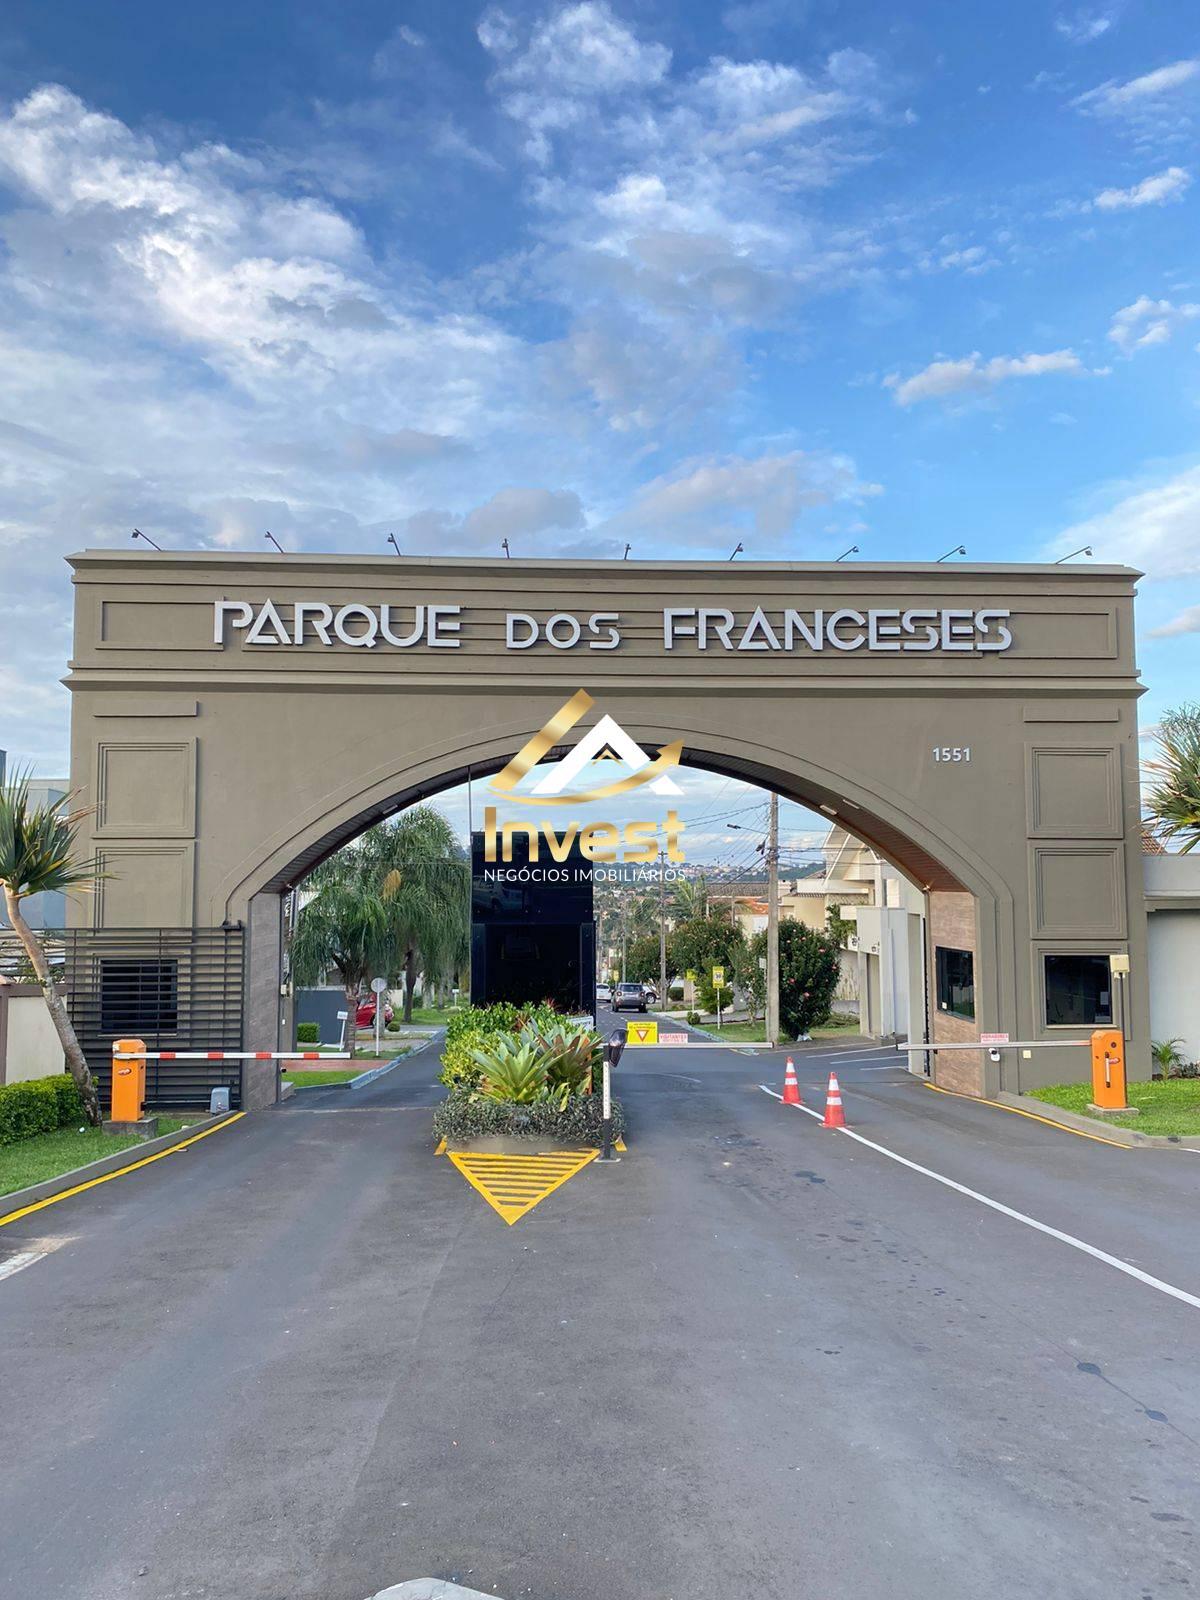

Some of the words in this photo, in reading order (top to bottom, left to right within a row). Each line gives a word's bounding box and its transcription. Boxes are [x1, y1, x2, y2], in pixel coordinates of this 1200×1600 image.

[214, 598, 461, 648] PARQUE
[506, 613, 621, 649] DOS
[663, 605, 1013, 651] FRANCESES
[932, 747, 971, 762] 1551
